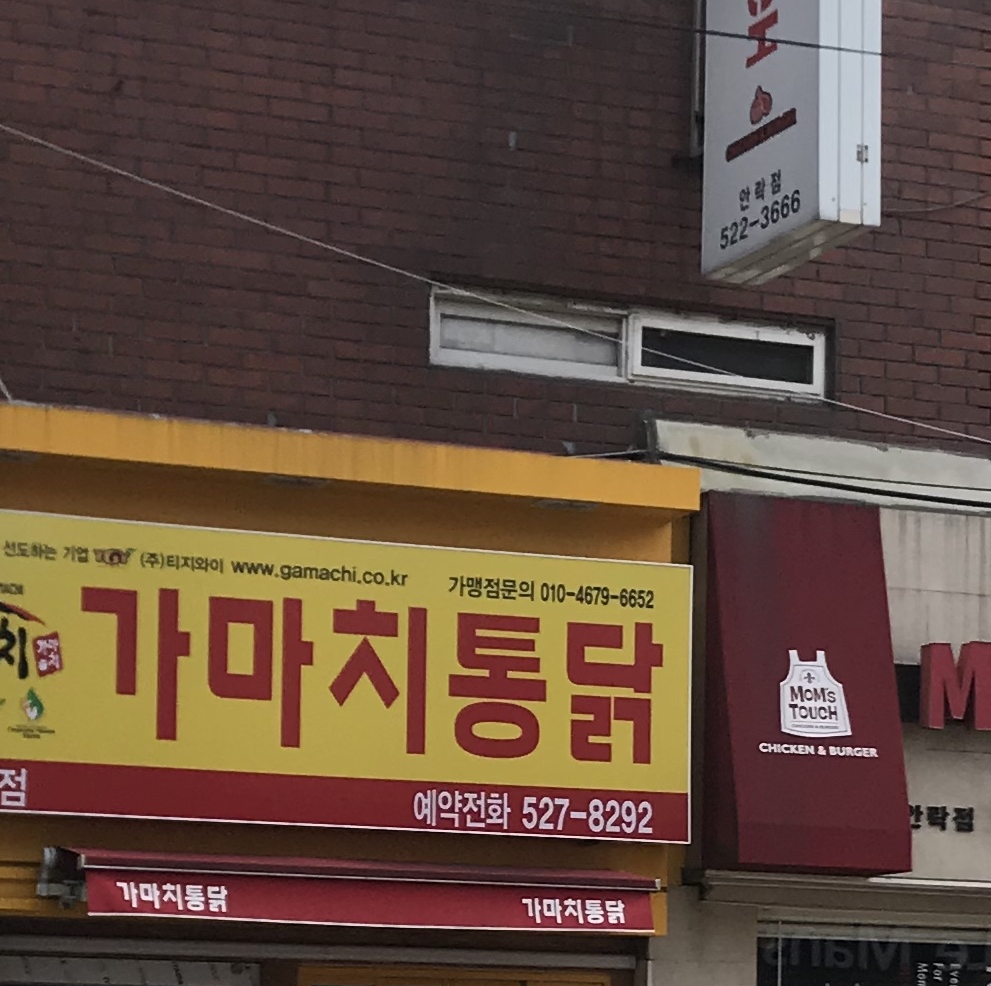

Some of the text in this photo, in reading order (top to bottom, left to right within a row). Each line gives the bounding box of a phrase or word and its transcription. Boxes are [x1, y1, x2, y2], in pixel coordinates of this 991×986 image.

[740, 169, 782, 211] 안락점
[719, 189, 801, 250] 522-3666
[3, 540, 57, 561] 선도하는
[63, 545, 89, 563] 기업
[139, 551, 225, 575] (주)티지와이
[230, 558, 409, 586] www.gamachi.co.kr
[448, 575, 655, 610] 가맹점문의 010-4679-6652
[81, 585, 664, 765] 가마치통닭
[759, 742, 879, 758] CHICKEN & BURGER
[413, 789, 654, 834] 예약전화 527-8292
[115, 881, 228, 913] 가마치통닭
[521, 898, 626, 925] 가마치통닭
